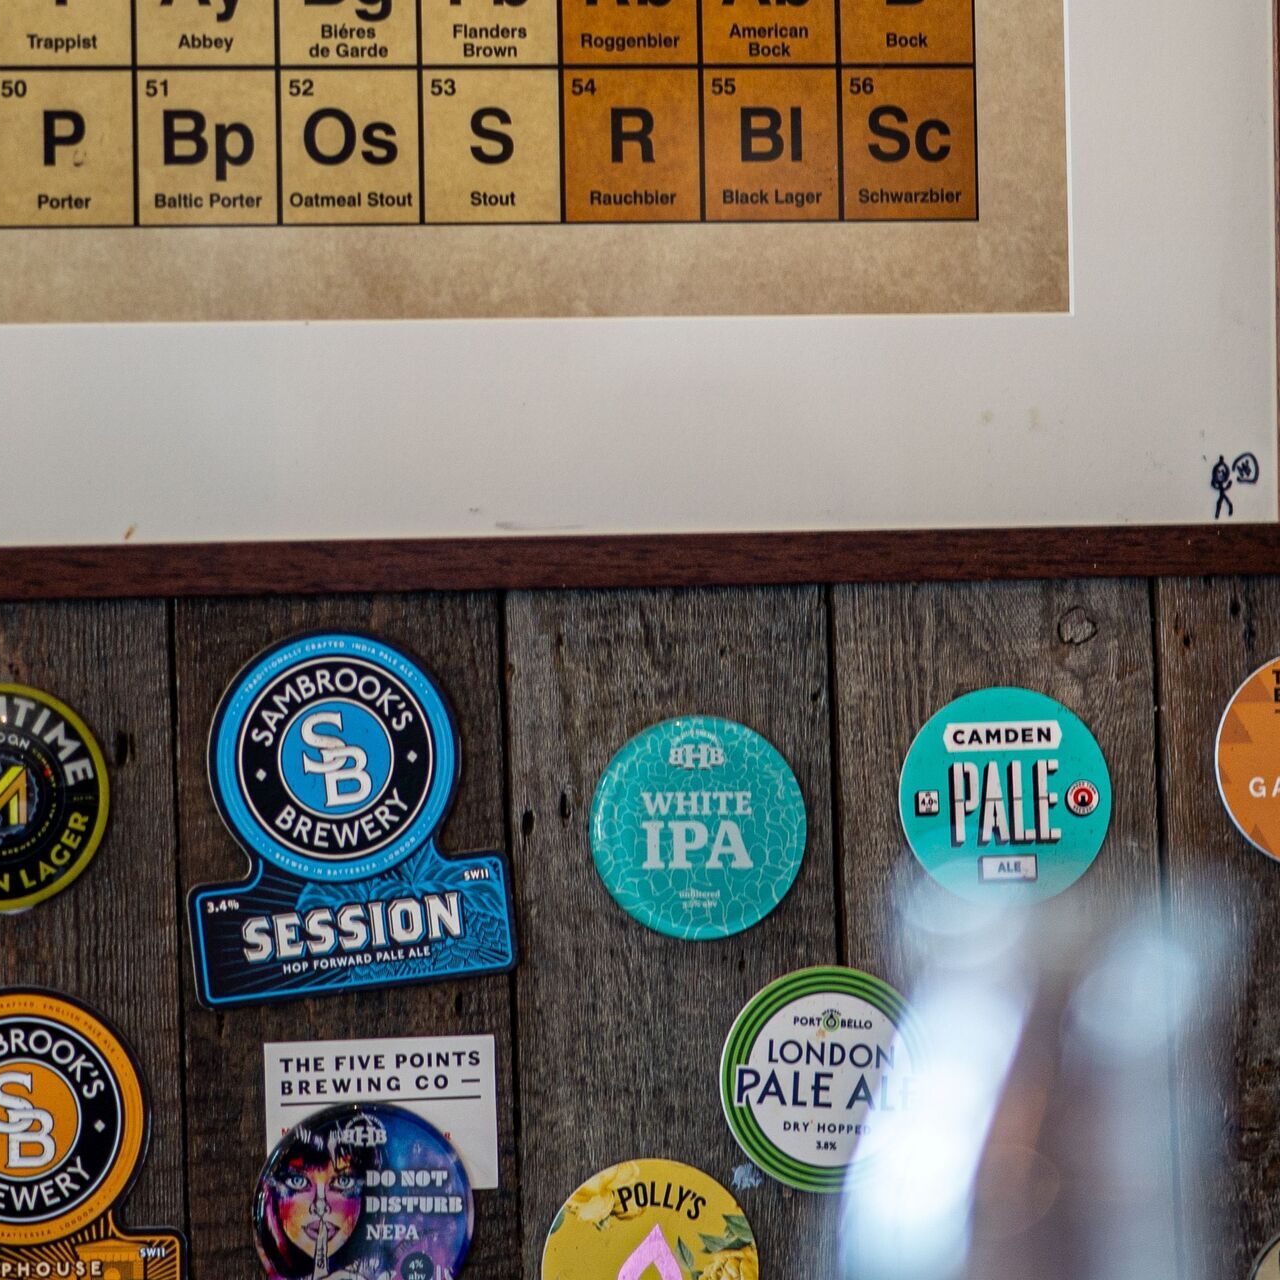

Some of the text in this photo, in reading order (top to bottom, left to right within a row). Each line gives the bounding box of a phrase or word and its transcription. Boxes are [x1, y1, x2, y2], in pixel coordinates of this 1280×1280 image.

[43, 109, 85, 166] P
[163, 109, 254, 181] Bp
[304, 107, 398, 166] Os
[470, 107, 514, 165] S
[611, 107, 655, 163] R
[740, 106, 802, 162] Bl
[868, 104, 951, 163] Sc
[252, 668, 414, 747] SAMBROOK'S
[953, 727, 1051, 745] CAMDEN
[274, 788, 409, 849] BREWERY
[641, 791, 753, 816] WHITE
[950, 759, 1062, 846] PALE
[21, 811, 89, 889] LAGER
[641, 820, 754, 869] IPA
[998, 861, 1021, 873] ALE
[242, 891, 463, 963] SESSION
[283, 945, 431, 975] HOP FORWARD PALE ALE
[279, 1051, 481, 1073] THE FIVE POINTS
[768, 1040, 895, 1069] LONDON
[280, 1075, 449, 1096] BREWING CO
[737, 1068, 834, 1108] PALE
[366, 1170, 448, 1187] DO NOT
[366, 1197, 463, 1213] DISTURB
[366, 1224, 419, 1240] NEPA
